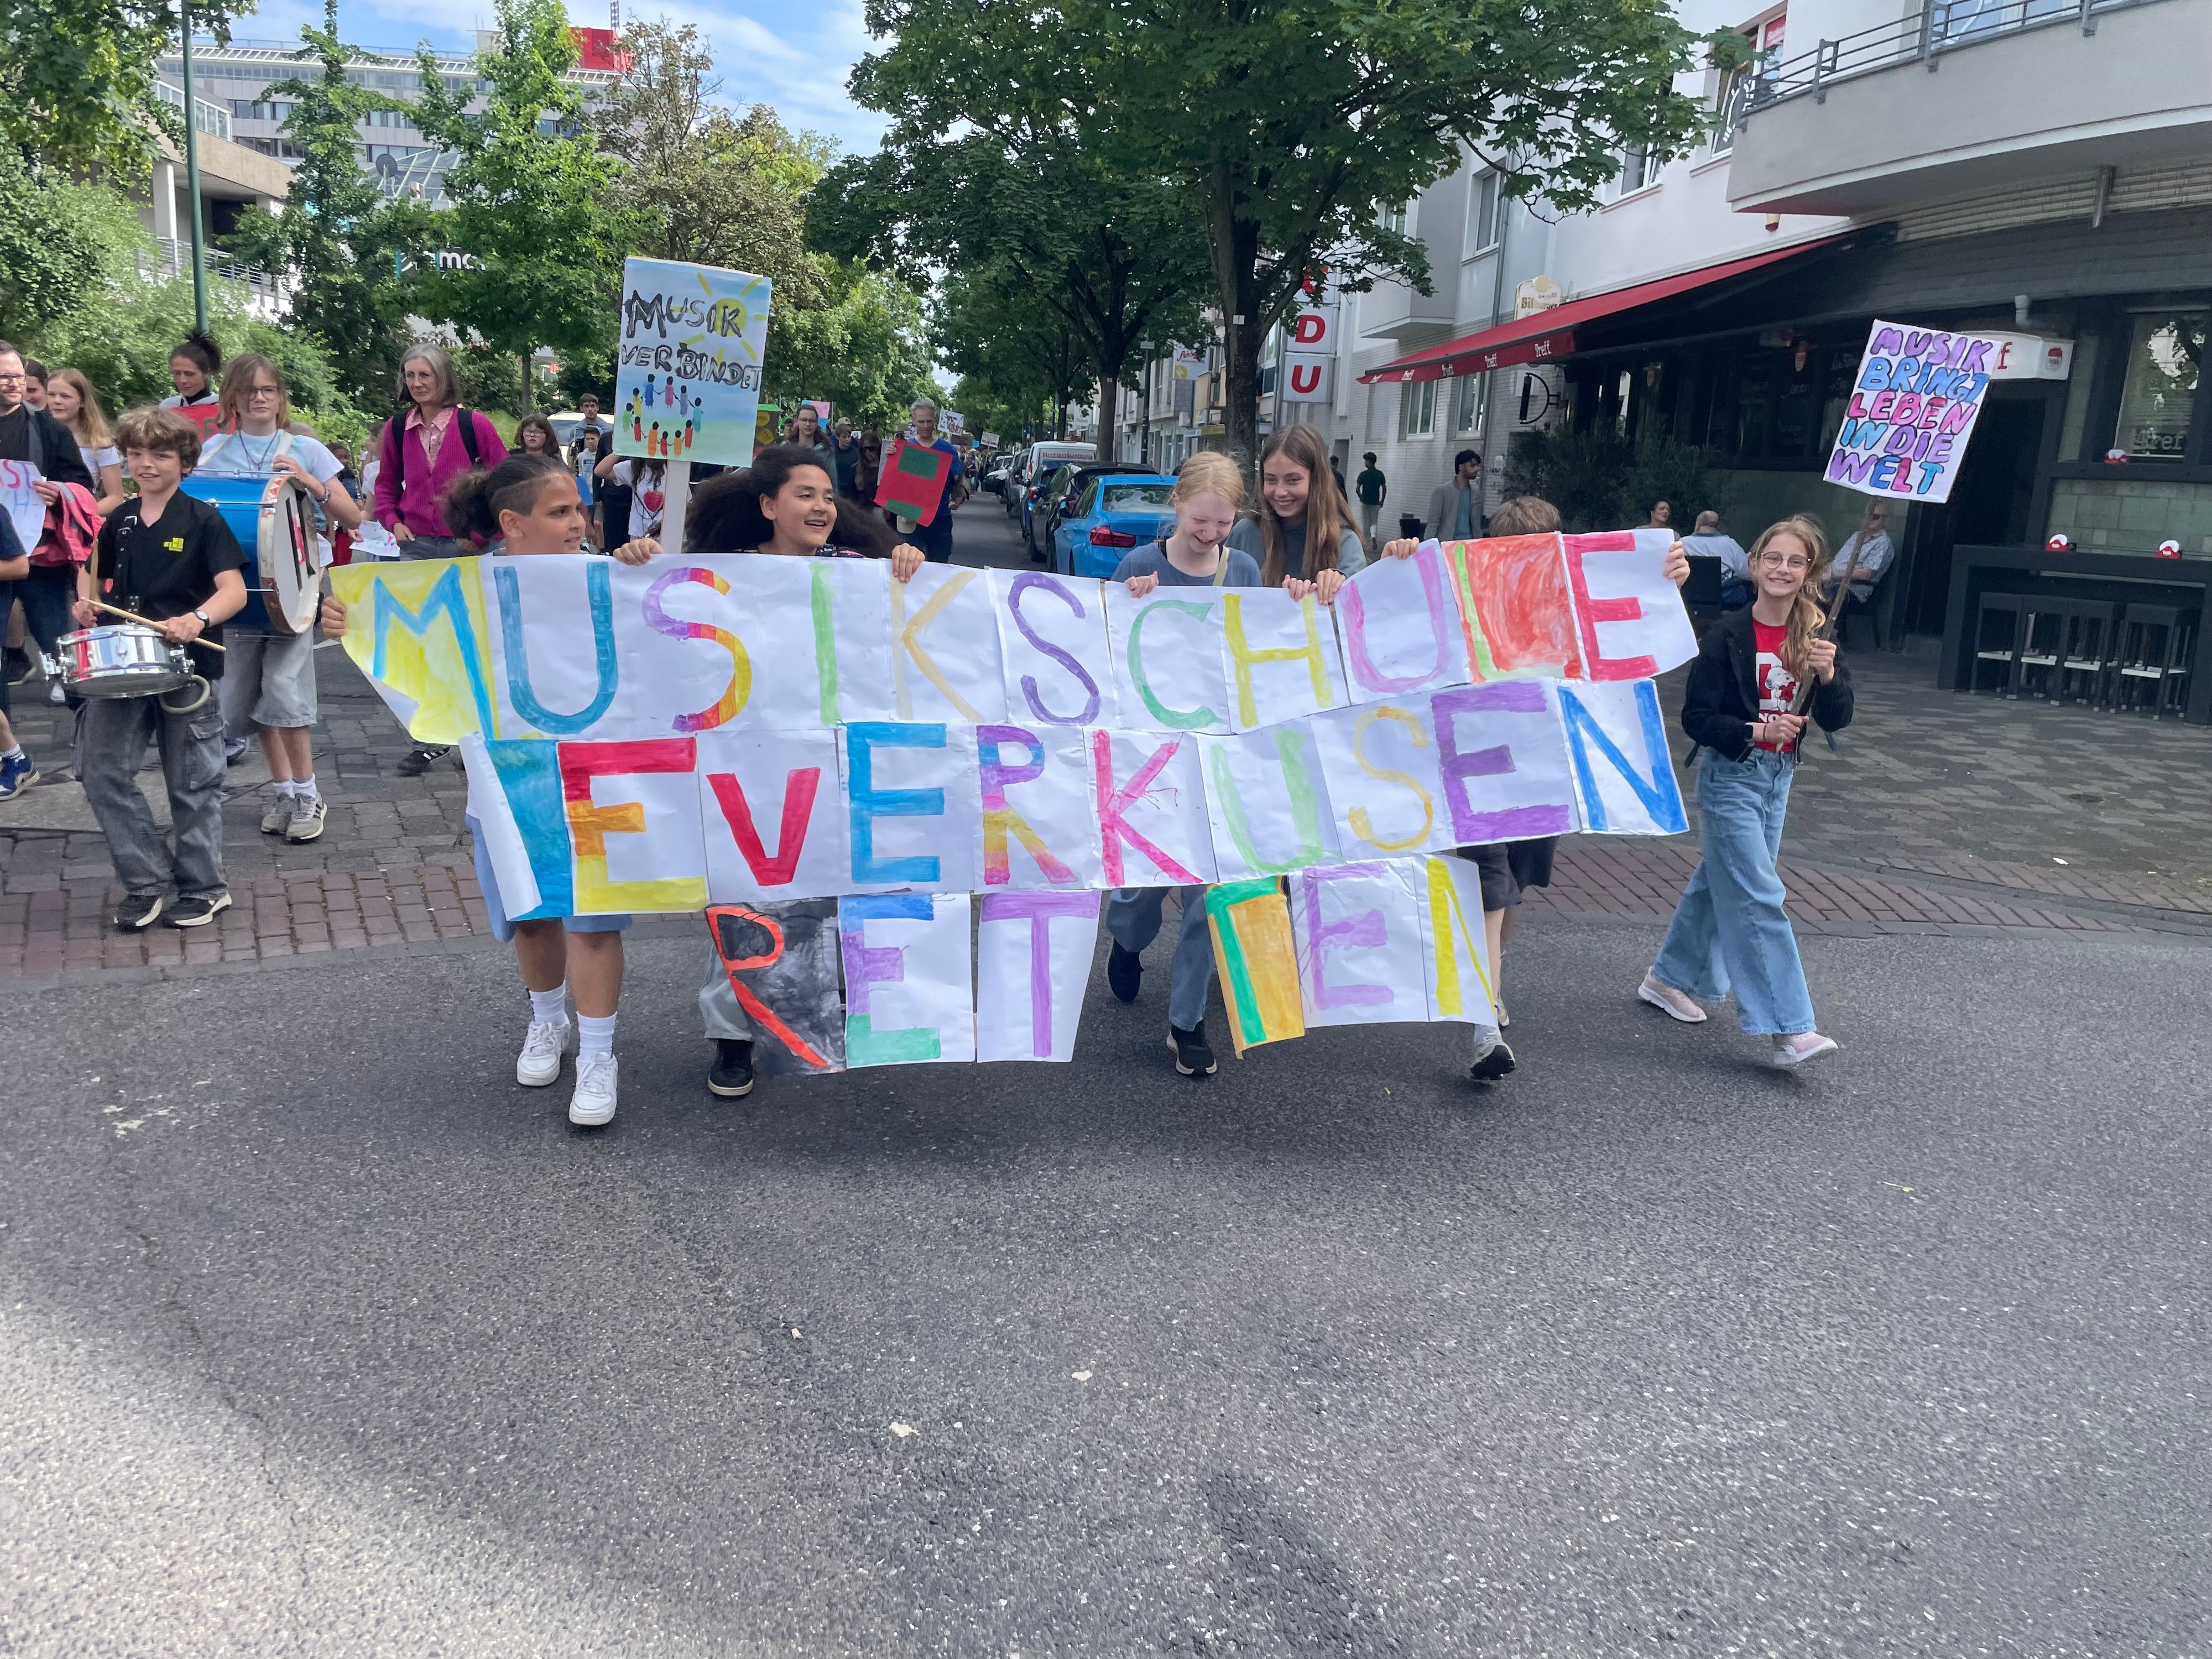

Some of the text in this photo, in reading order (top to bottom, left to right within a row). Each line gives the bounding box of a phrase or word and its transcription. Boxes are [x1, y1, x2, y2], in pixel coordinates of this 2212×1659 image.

[623, 290, 742, 339] MUSIK
[1870, 327, 1994, 374] MUSIK
[1858, 357, 1991, 403] BRINGT
[1846, 390, 1978, 435] LEBEN
[1839, 419, 1954, 463] IN DIE
[1829, 448, 1944, 494] WELT
[373, 532, 1661, 740] MUSIKSCHULE
[498, 680, 1689, 915] EVERKUSEN
[706, 857, 1495, 1072] RETTEN
